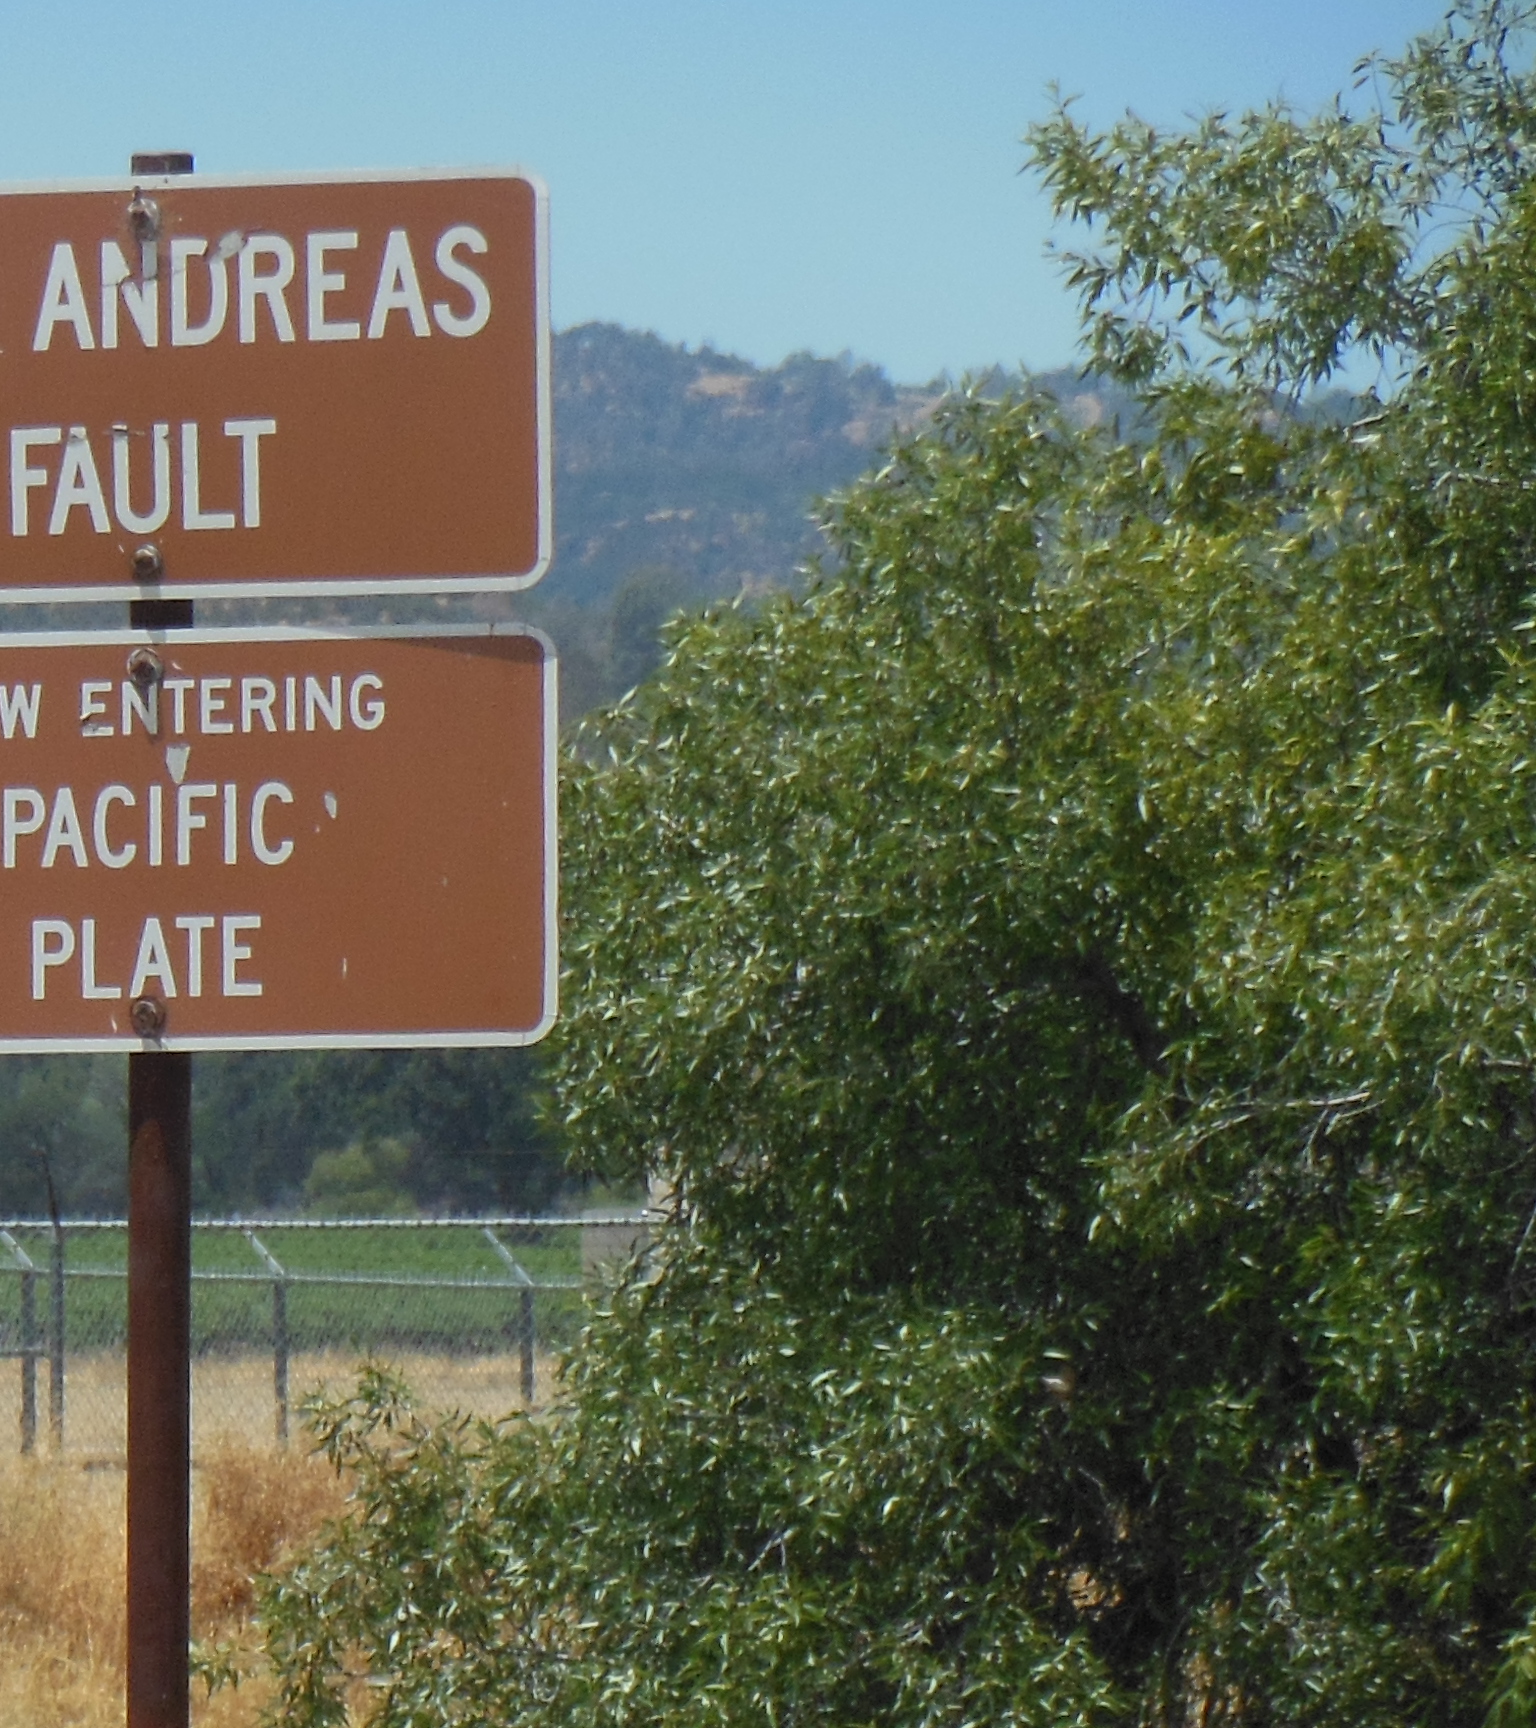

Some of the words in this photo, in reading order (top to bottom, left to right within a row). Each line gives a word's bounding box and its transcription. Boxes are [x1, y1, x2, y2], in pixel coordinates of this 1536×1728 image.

[31, 225, 492, 352] ANDREAS
[9, 419, 277, 537] FAULT
[80, 673, 386, 738] ENTERING
[2, 781, 295, 869] PACIFIC
[31, 915, 263, 1001] PLATE
